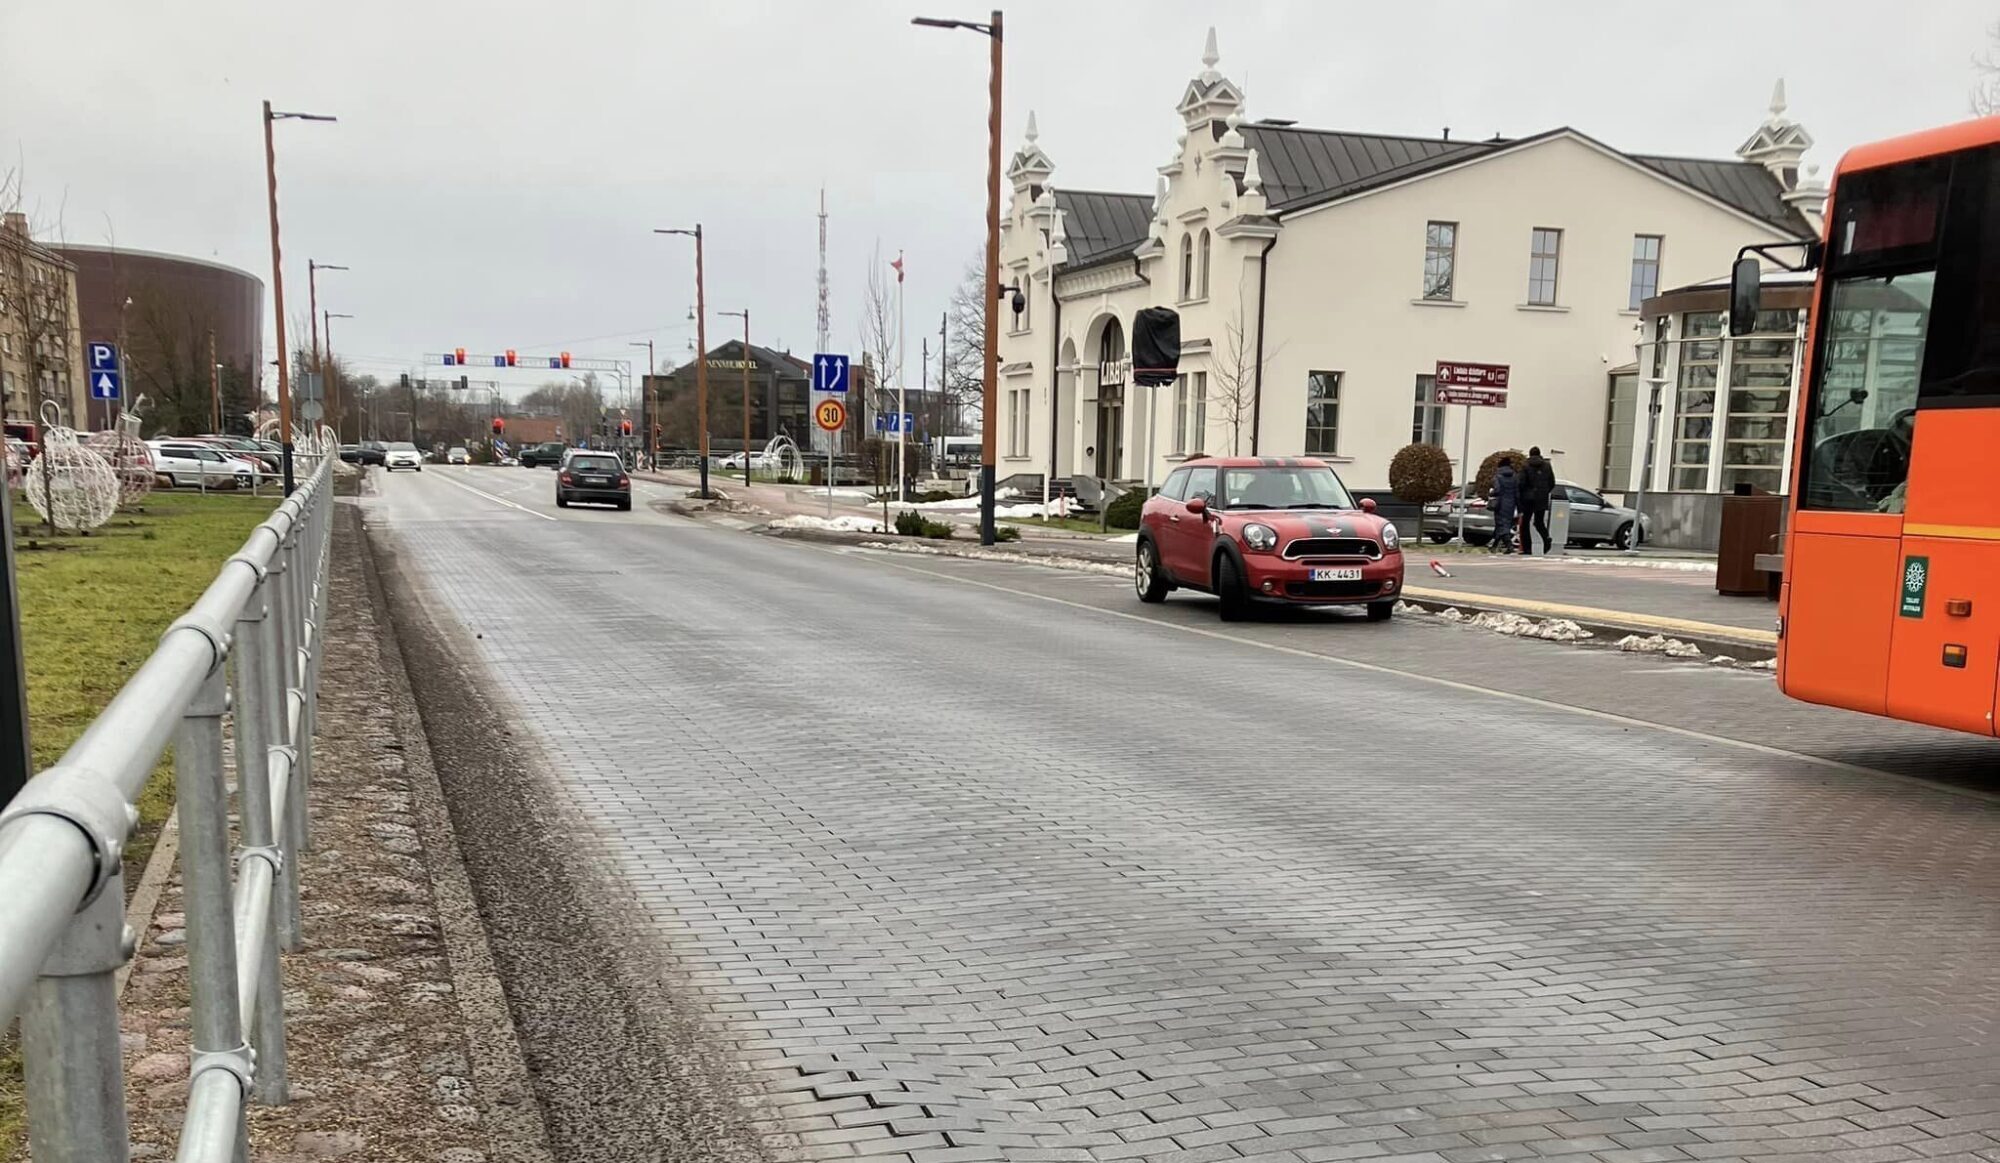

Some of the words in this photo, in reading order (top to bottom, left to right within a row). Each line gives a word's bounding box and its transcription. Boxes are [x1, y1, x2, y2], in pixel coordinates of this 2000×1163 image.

[94, 345, 110, 367] P
[823, 408, 838, 423] 30
[1316, 569, 1360, 579] KK-4431
